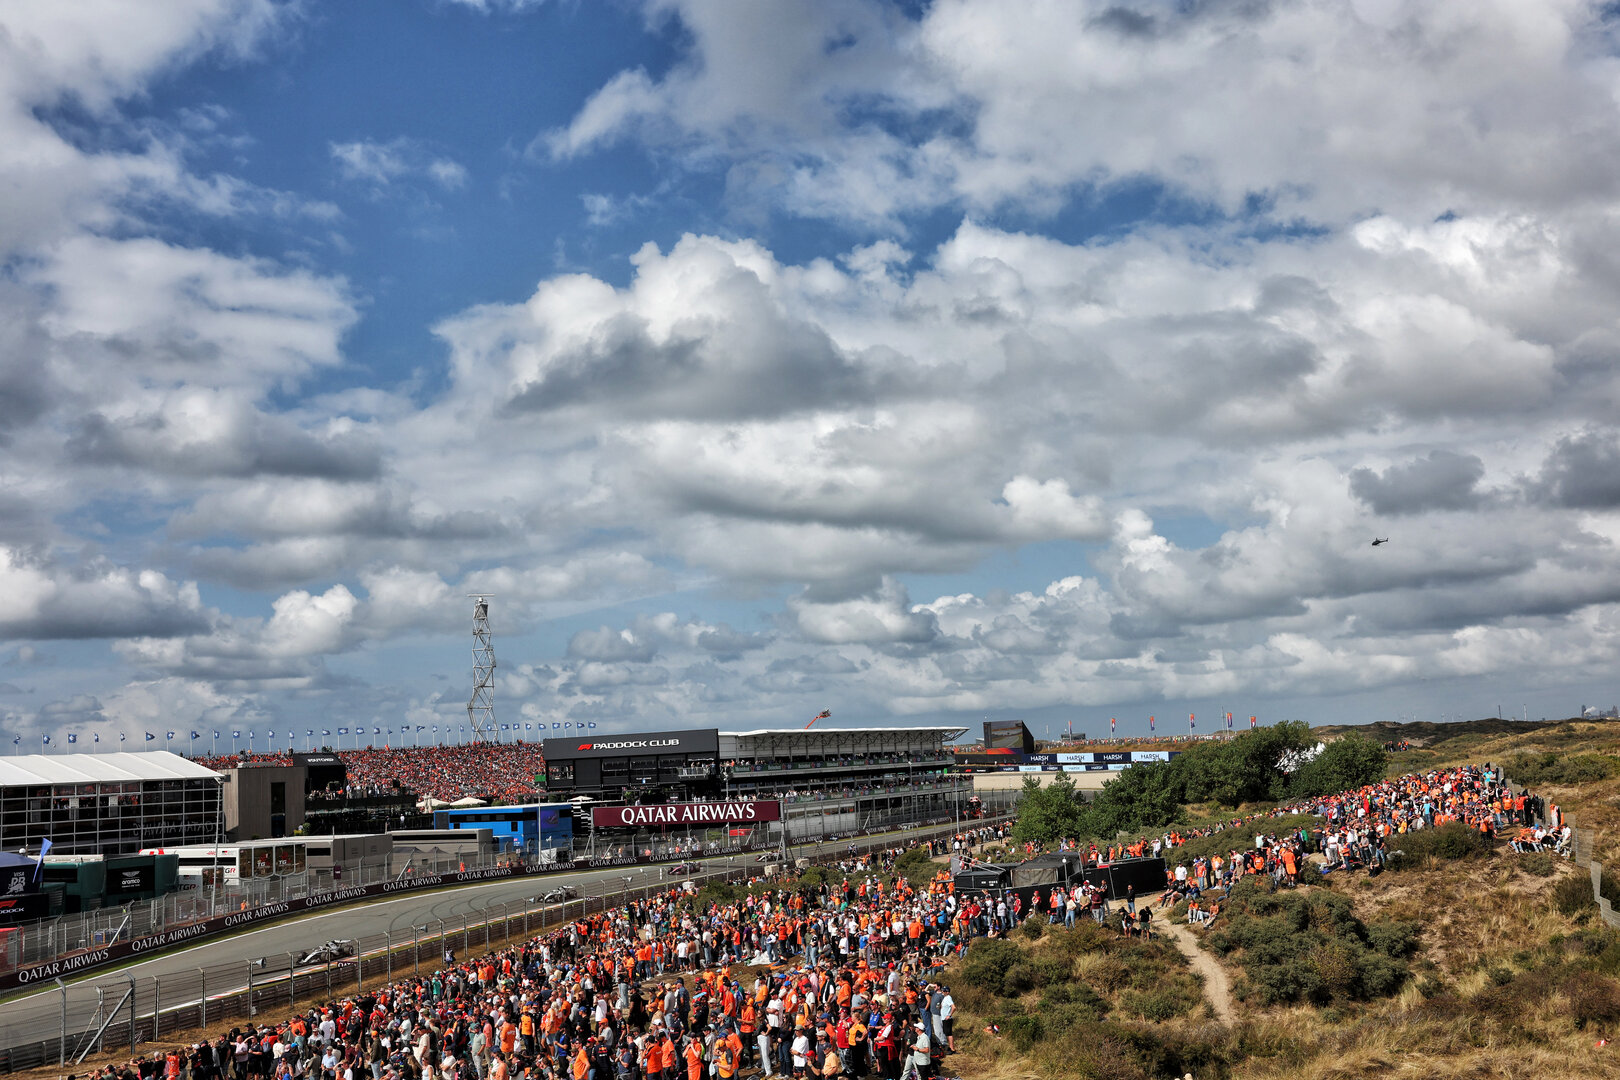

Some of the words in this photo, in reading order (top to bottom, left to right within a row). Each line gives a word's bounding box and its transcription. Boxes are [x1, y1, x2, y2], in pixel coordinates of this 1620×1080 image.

[593, 740, 647, 750] PADDOCK
[649, 739, 680, 747] CLUB
[621, 806, 678, 825] QATAR
[681, 802, 756, 821] AIRWAYS
[649, 852, 669, 862] QATAR
[669, 851, 692, 860] AIRWAYS
[703, 848, 720, 856] QATAR
[720, 846, 742, 855] AIRWAYS
[525, 864, 548, 873] QATAR
[548, 862, 576, 871] AIRWAYS
[589, 858, 611, 867] QATAR
[611, 857, 637, 866] AIRWAYS
[457, 871, 482, 881] QATAR
[482, 868, 512, 878] AIRWAYS
[383, 880, 409, 892] QATAR
[410, 875, 442, 887] AIRWAYS
[305, 893, 333, 907] QATAR
[333, 886, 367, 900] AIRWAYS
[224, 911, 253, 927] QATAR
[254, 902, 289, 918] AIRWAYS
[131, 934, 167, 952] QATAR
[167, 922, 207, 943] AIRWAYS
[18, 962, 60, 983] QATAR
[62, 948, 110, 972] AIRWAYS
